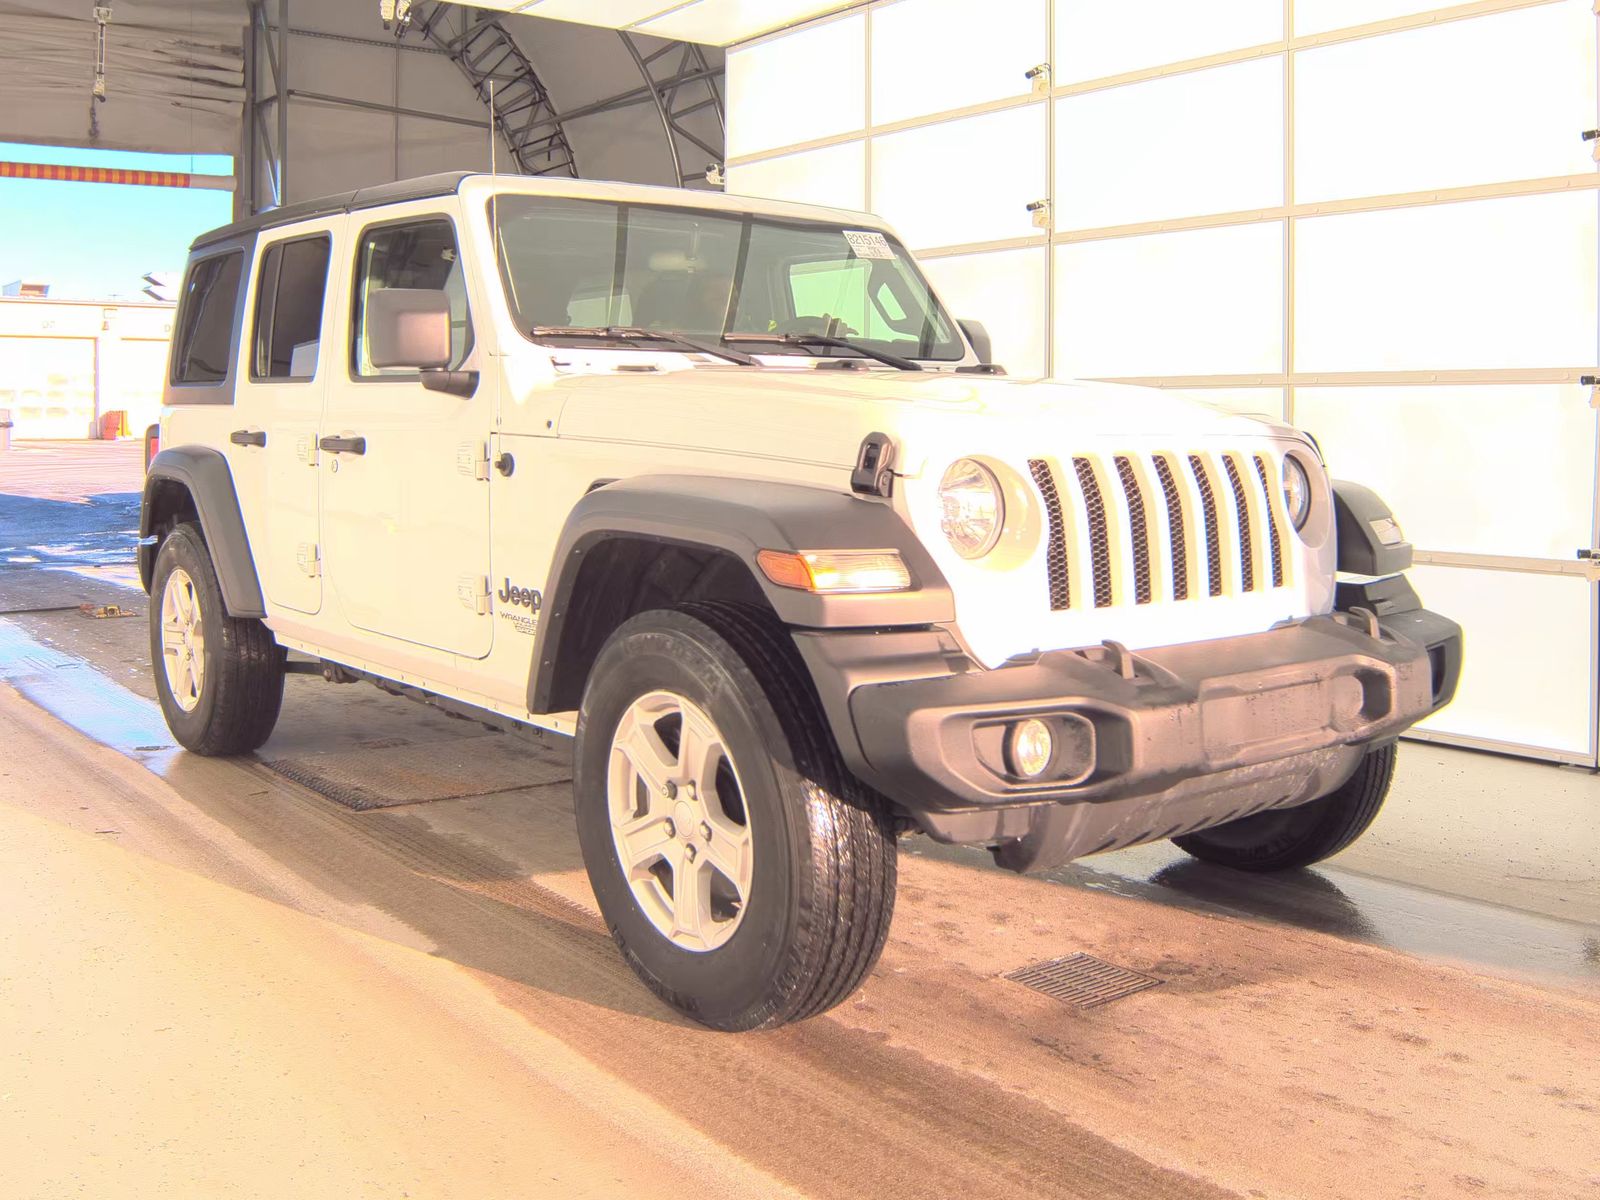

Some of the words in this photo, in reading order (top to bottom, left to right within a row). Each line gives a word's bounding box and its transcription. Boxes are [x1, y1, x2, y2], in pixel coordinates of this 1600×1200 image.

[846, 233, 888, 247] 8215146
[498, 577, 542, 615] Jeep
[499, 610, 538, 625] WRANGLE
